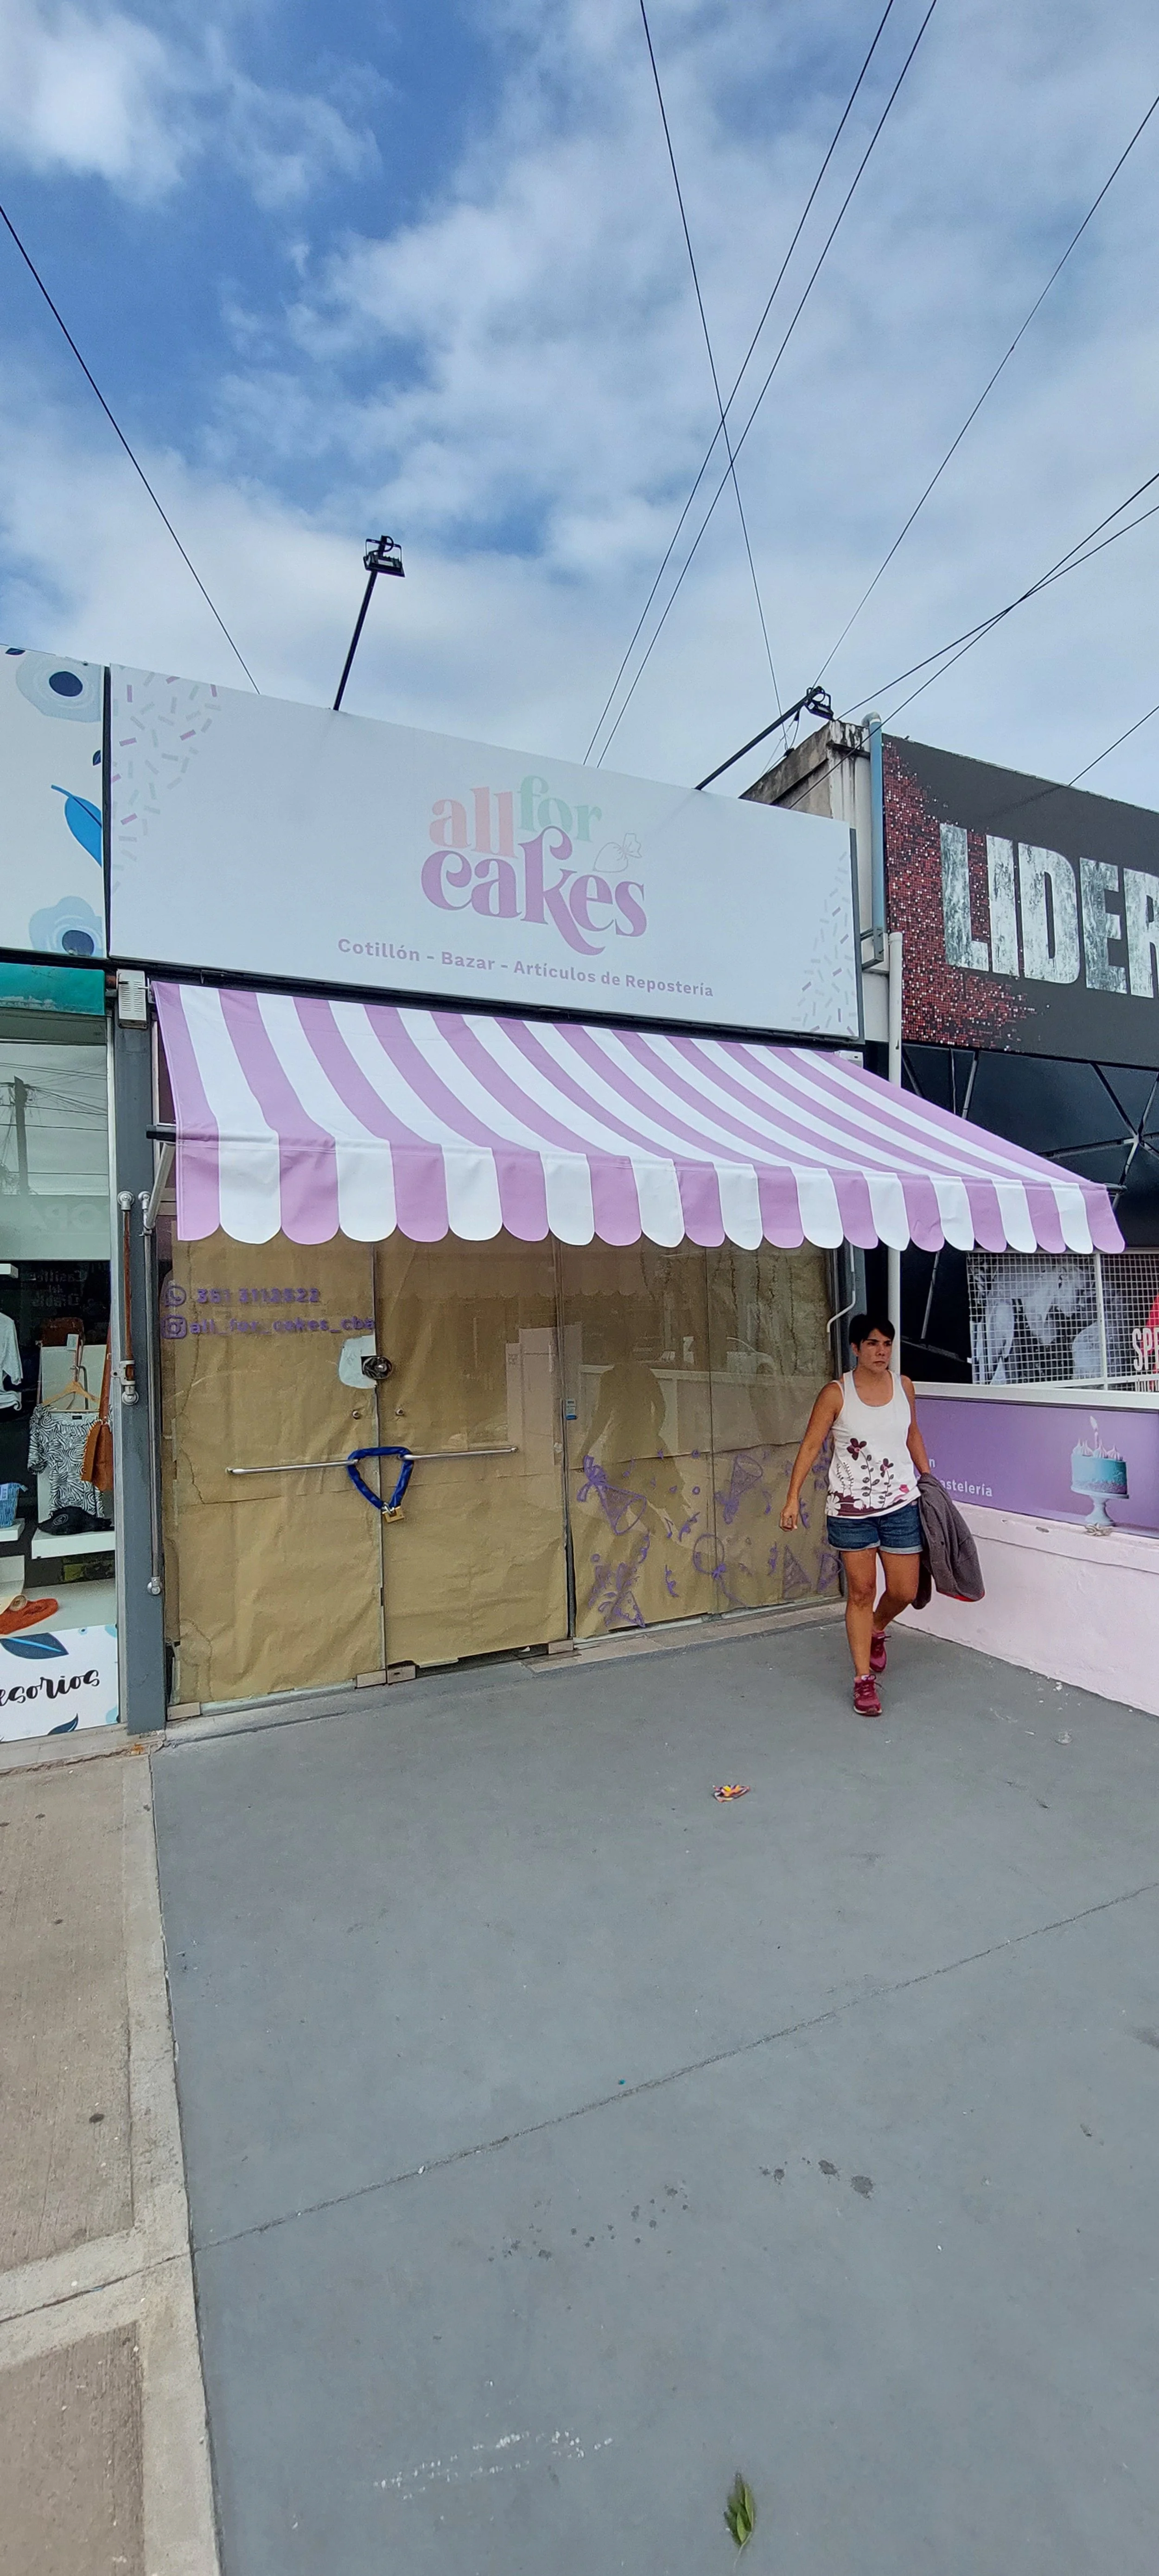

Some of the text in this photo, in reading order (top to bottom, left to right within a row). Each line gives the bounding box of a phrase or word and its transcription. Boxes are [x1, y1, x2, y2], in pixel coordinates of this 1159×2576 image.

[428, 774, 603, 859] all for
[420, 825, 648, 956] cakes
[940, 823, 1159, 999] LIDER
[338, 938, 420, 962] Cotillón
[441, 951, 495, 970] Bazar
[514, 961, 596, 983] Artículos
[601, 970, 621, 986] de
[625, 975, 713, 996] Repostería
[939, 1479, 993, 1497] astelería
